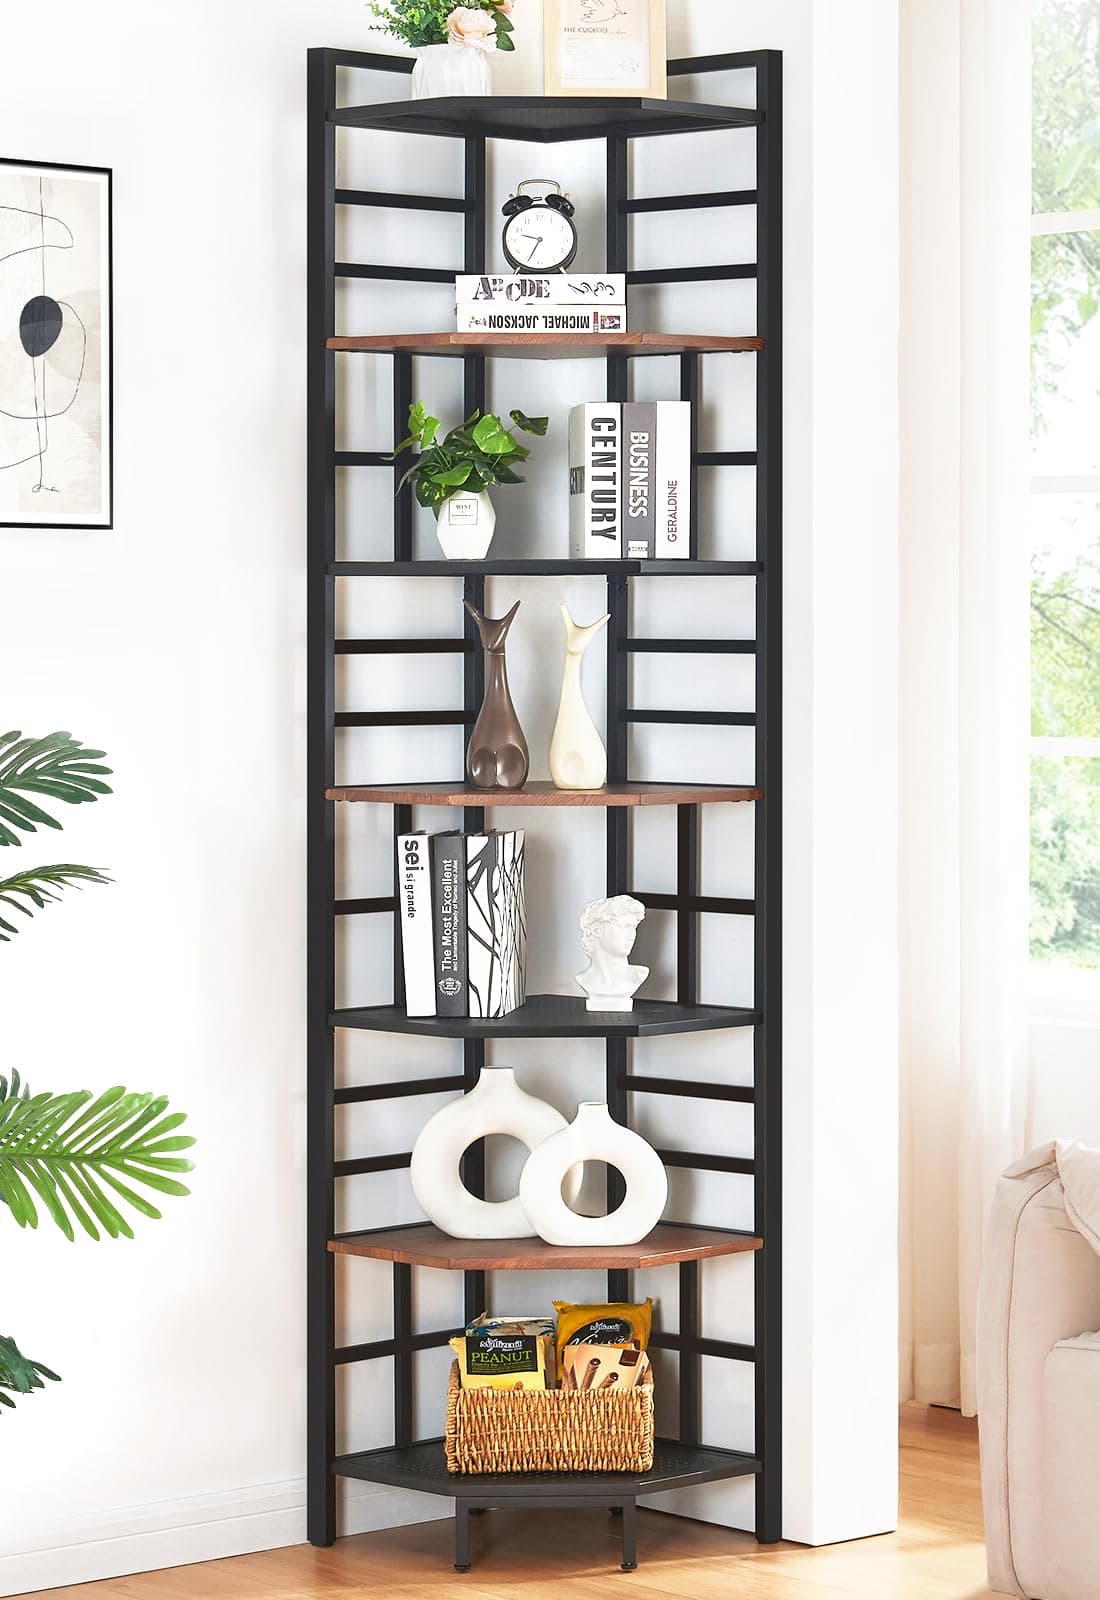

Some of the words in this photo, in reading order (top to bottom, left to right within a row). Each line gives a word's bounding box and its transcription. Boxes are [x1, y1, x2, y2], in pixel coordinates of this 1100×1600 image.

[472, 277, 551, 301] ABCDE
[488, 315, 539, 328] JACKSON
[542, 315, 590, 328] MICHAEL
[591, 417, 617, 541] CENTURY
[628, 431, 650, 519] BUSINESS
[667, 480, 678, 543] GERALDINE
[404, 839, 424, 871] sei
[406, 873, 416, 882] si
[441, 859, 453, 914] Excellent
[404, 884, 417, 919] grande
[441, 916, 453, 946] Most
[441, 949, 453, 972] The
[471, 1351, 532, 1363] PEANUT
